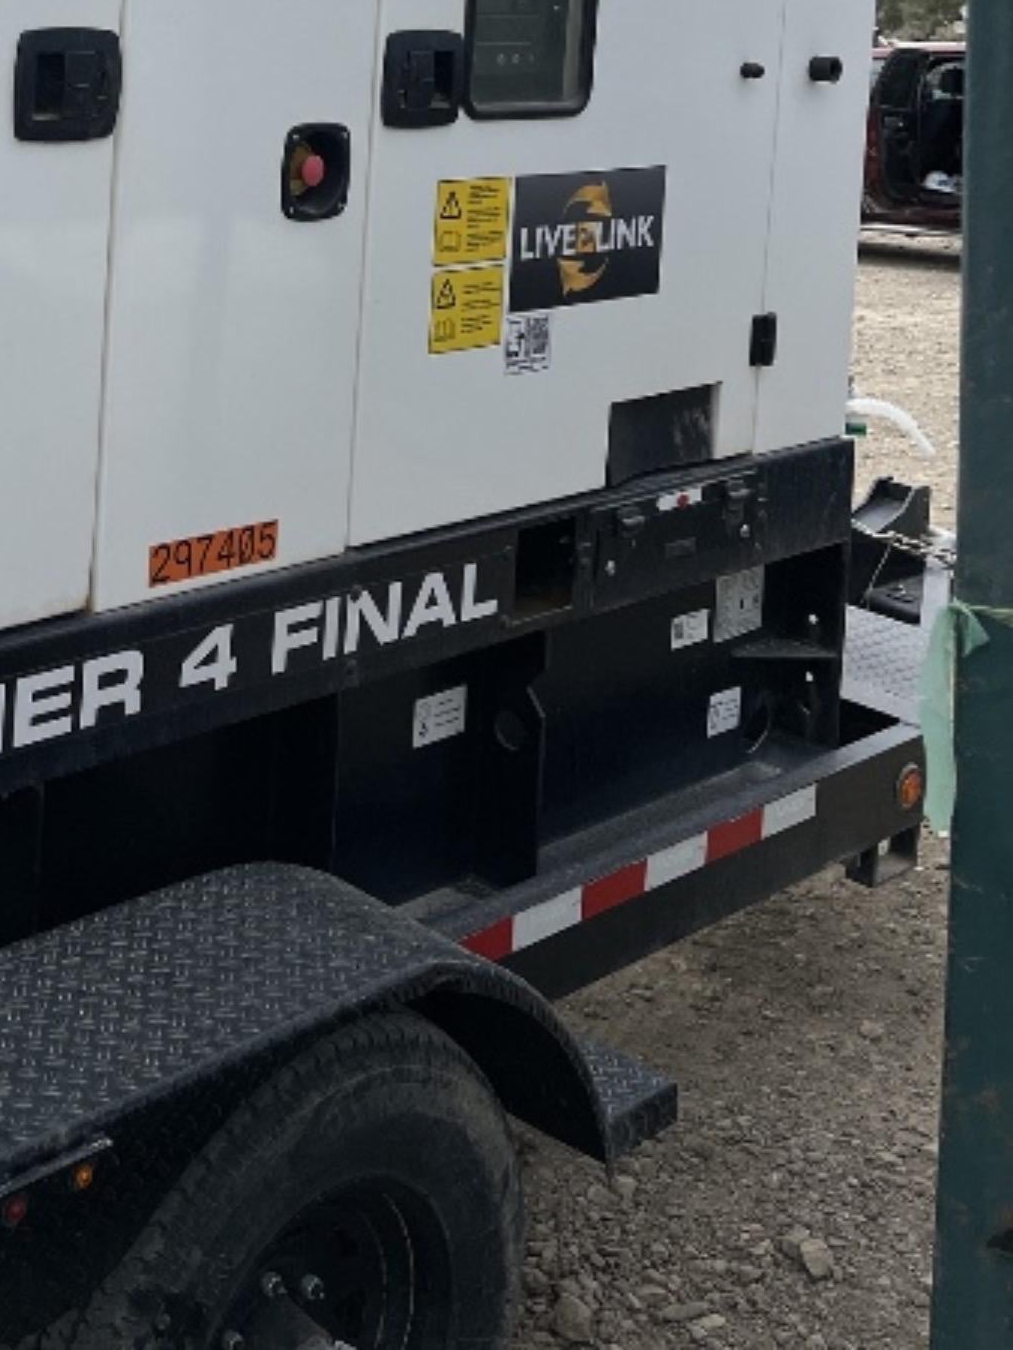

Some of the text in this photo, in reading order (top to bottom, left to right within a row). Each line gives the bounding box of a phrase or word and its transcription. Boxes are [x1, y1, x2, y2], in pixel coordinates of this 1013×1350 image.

[149, 520, 278, 585] 297405
[180, 623, 237, 691] 4
[272, 562, 498, 675] FINAL
